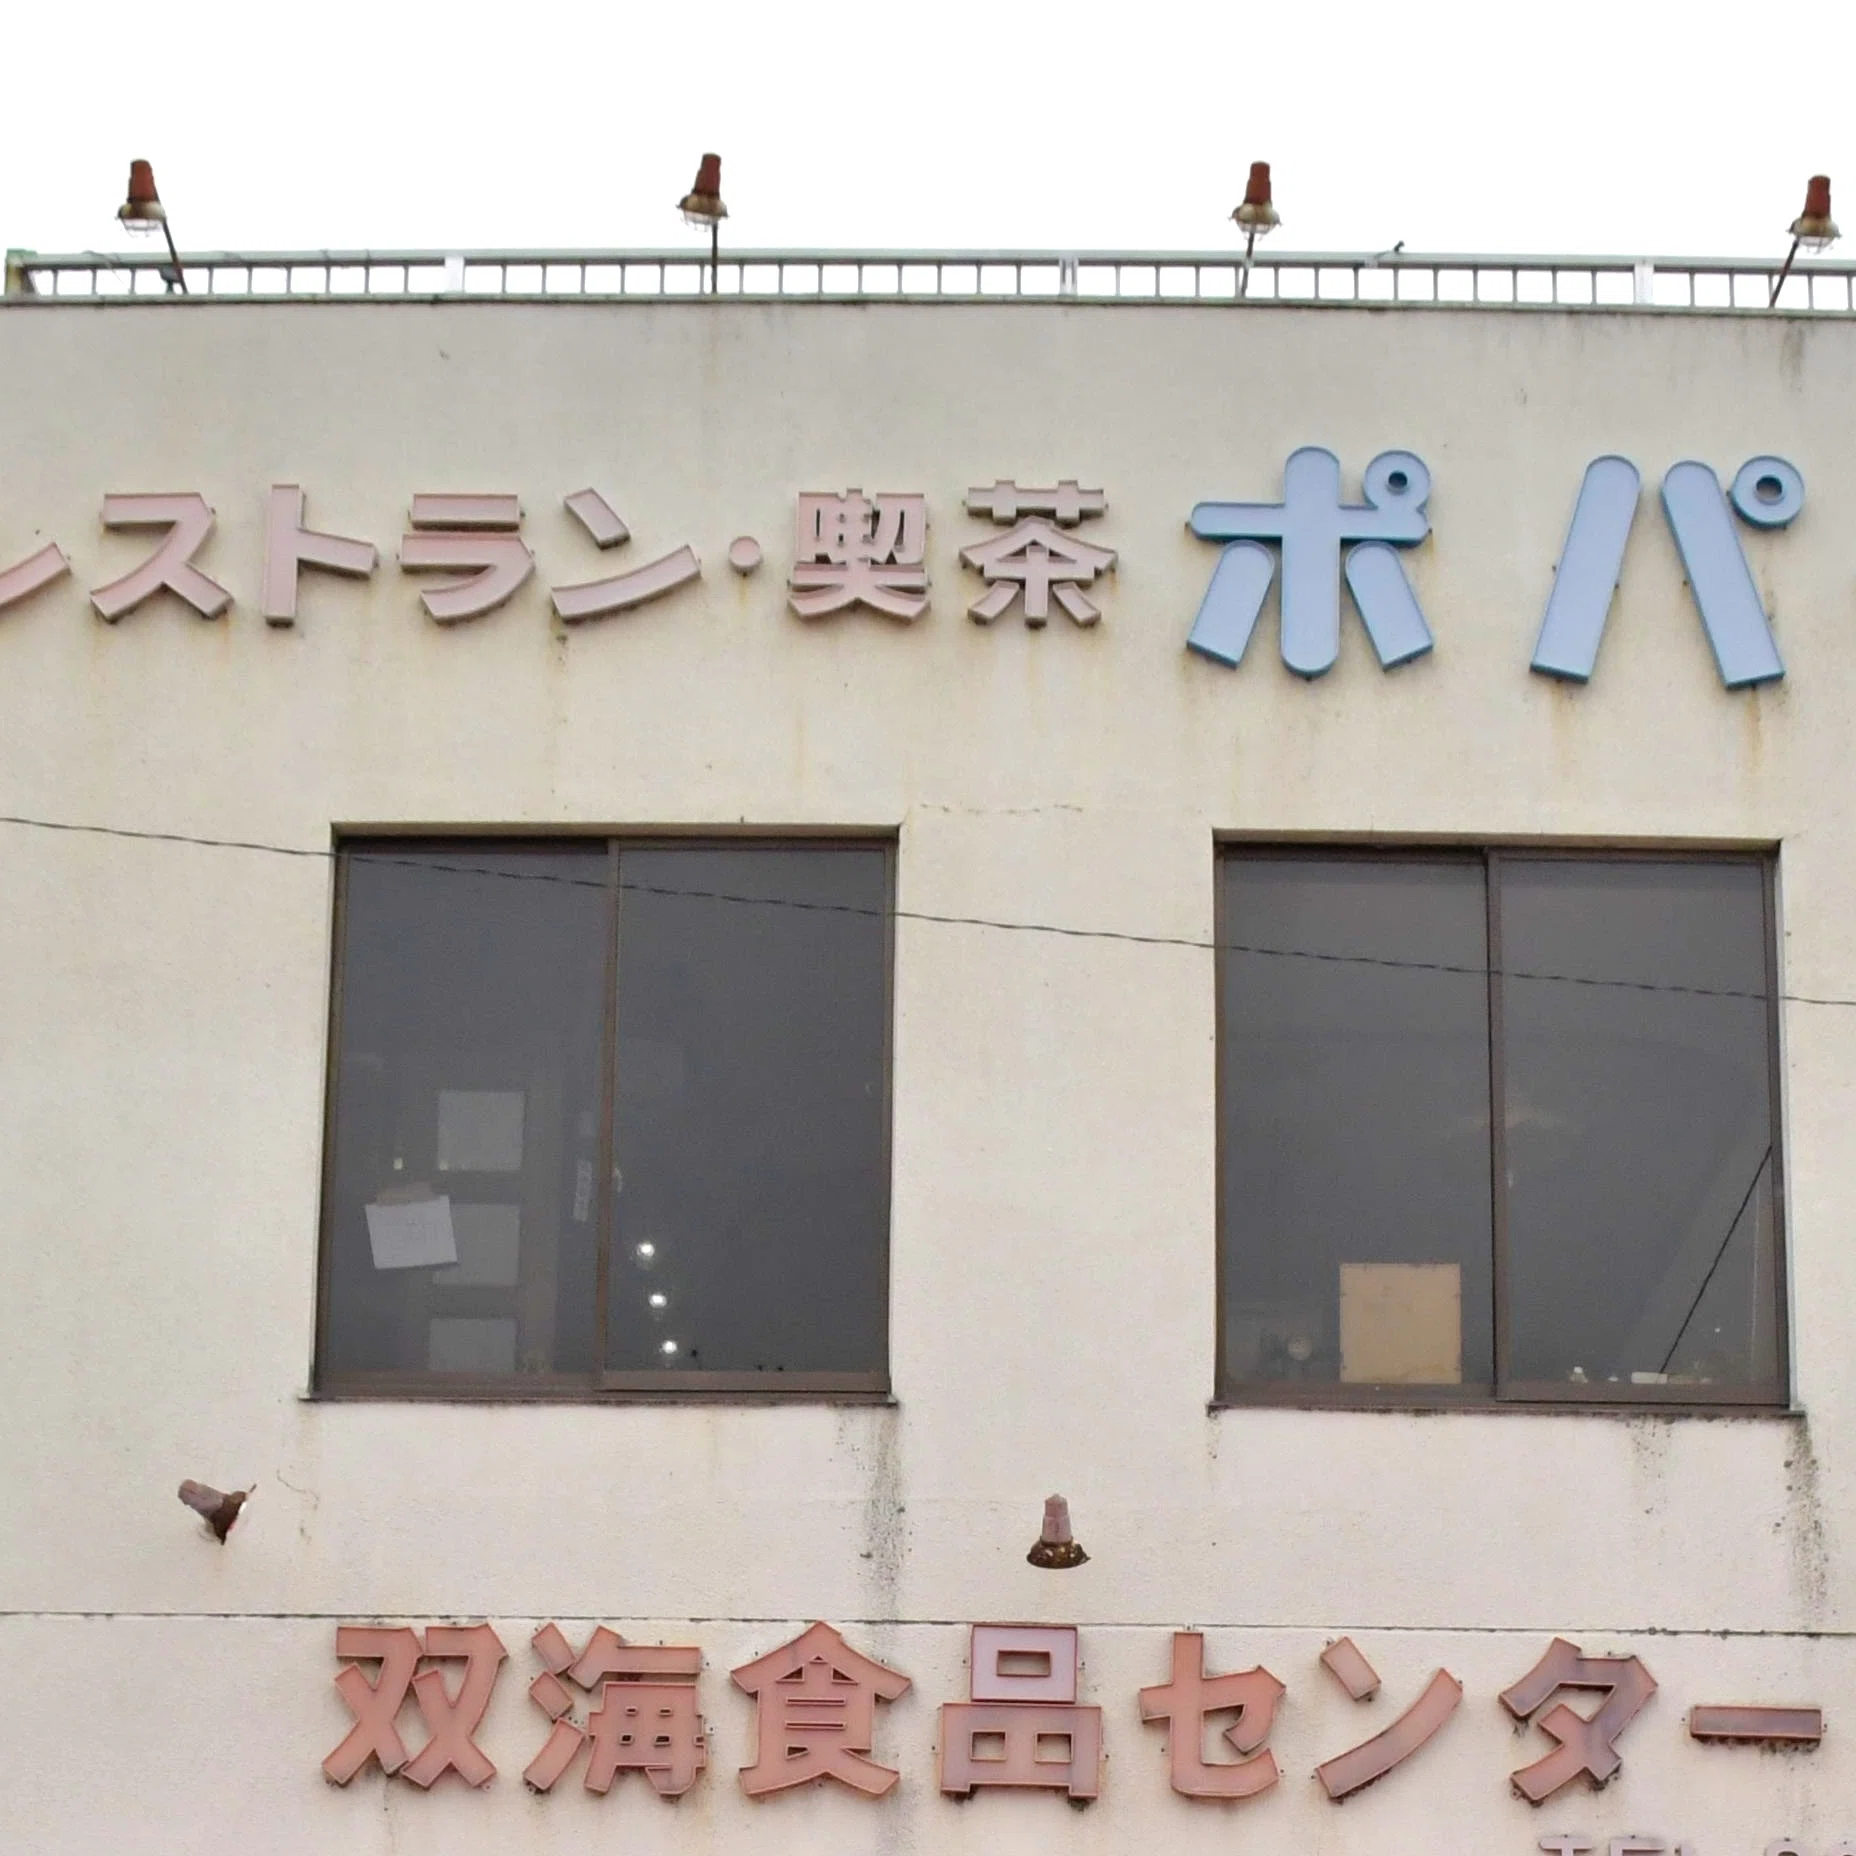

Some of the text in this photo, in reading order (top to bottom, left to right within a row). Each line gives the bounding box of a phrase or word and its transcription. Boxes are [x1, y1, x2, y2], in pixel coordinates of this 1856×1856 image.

[322, 1620, 1826, 1804] 双海食品センター
